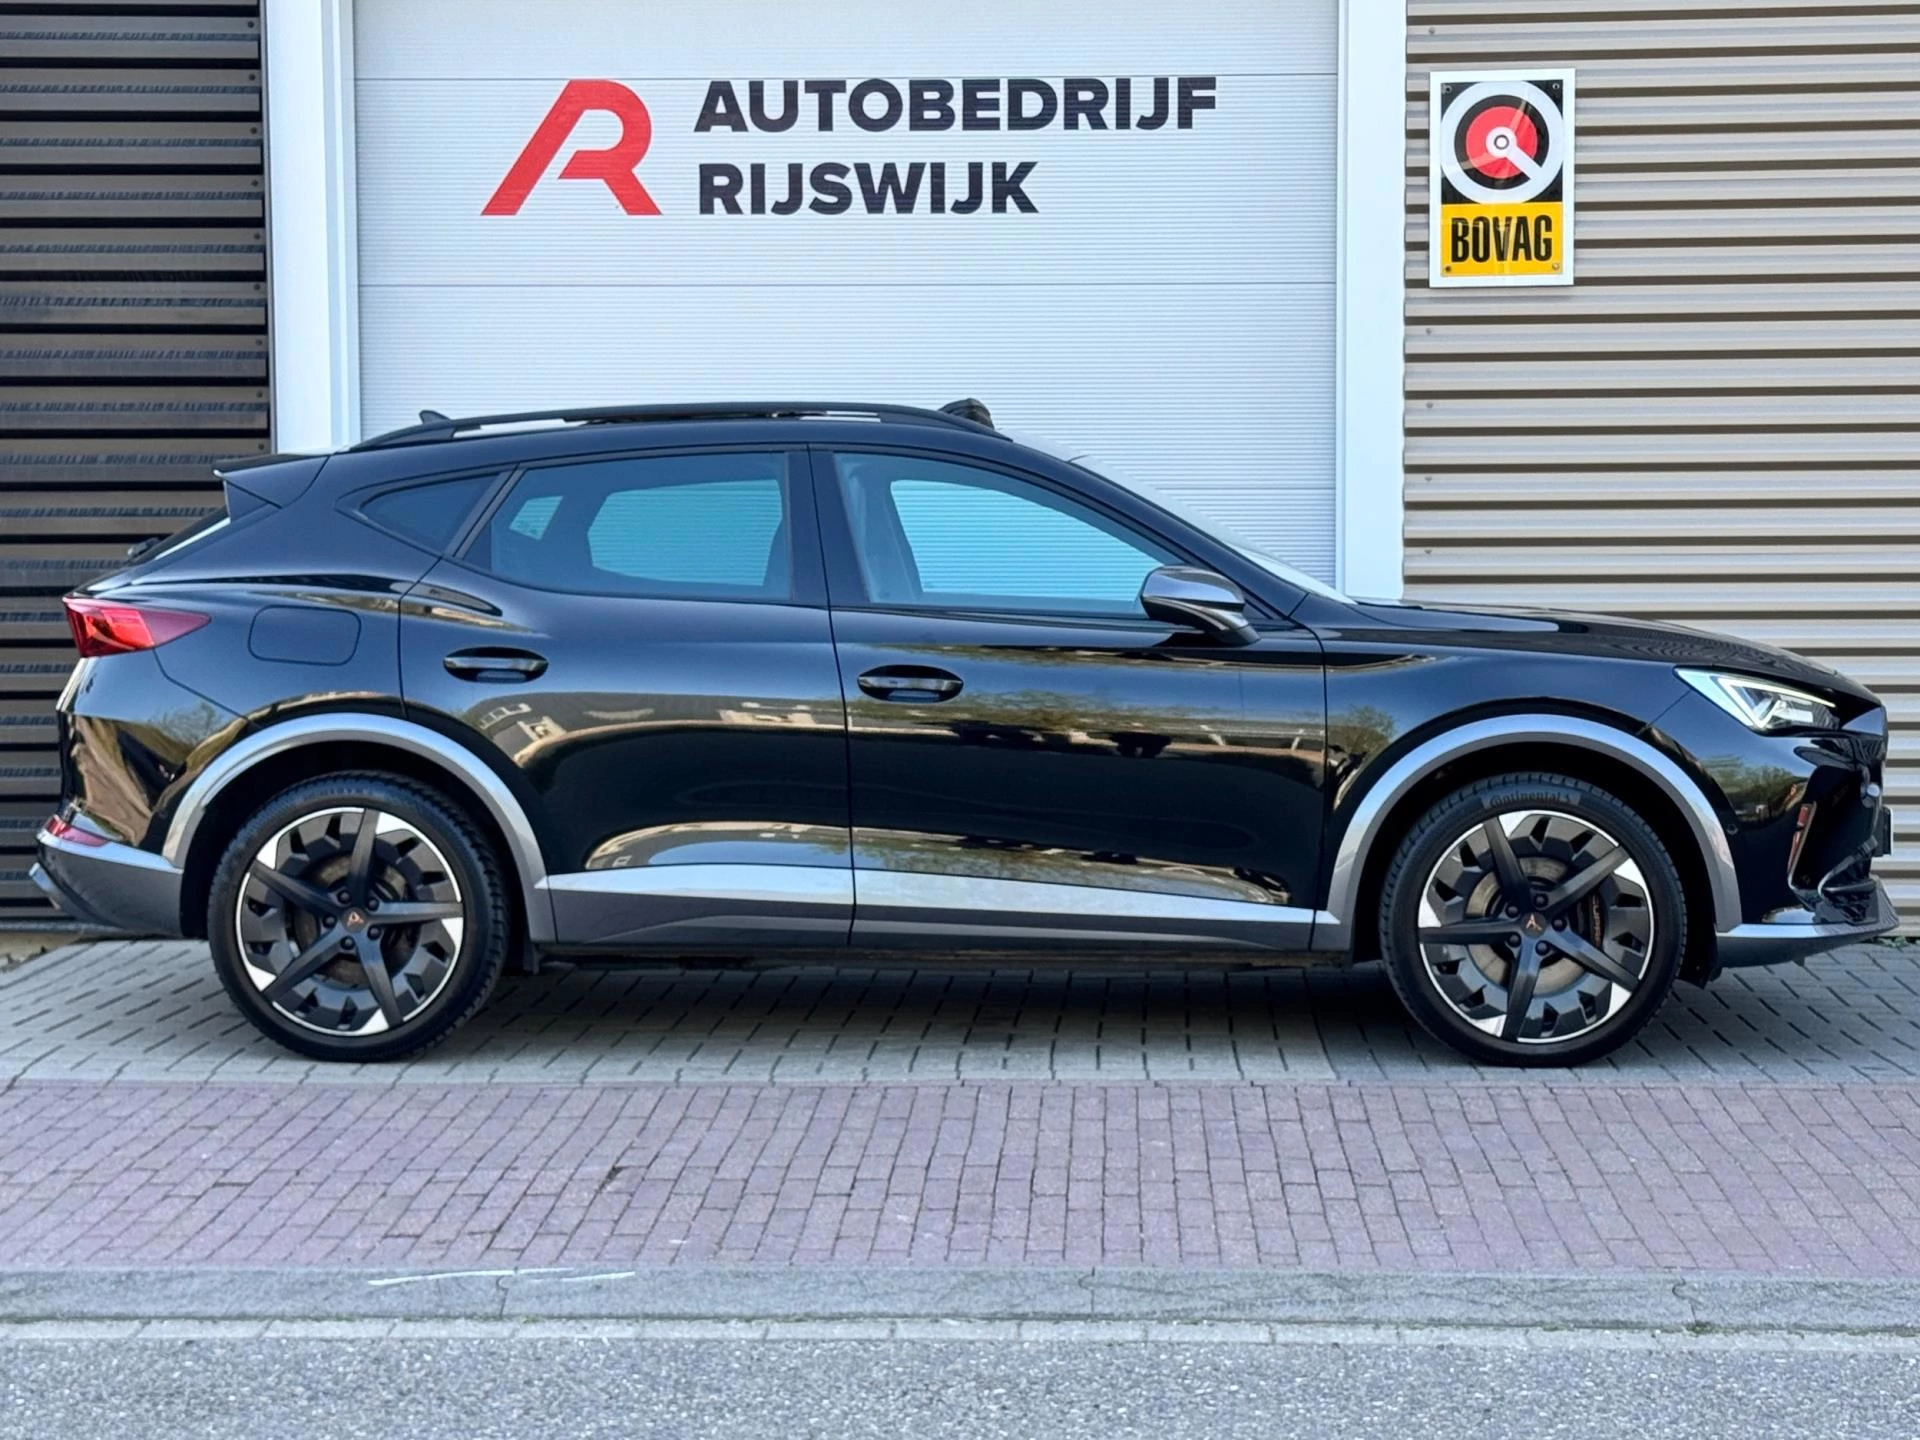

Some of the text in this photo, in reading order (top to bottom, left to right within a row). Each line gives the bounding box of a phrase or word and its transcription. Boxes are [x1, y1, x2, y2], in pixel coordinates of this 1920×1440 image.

[693, 76, 1217, 133] AUTOBEDRIJF
[699, 160, 1040, 216] RIJSWIJK
[1451, 214, 1553, 263] BOVAG
